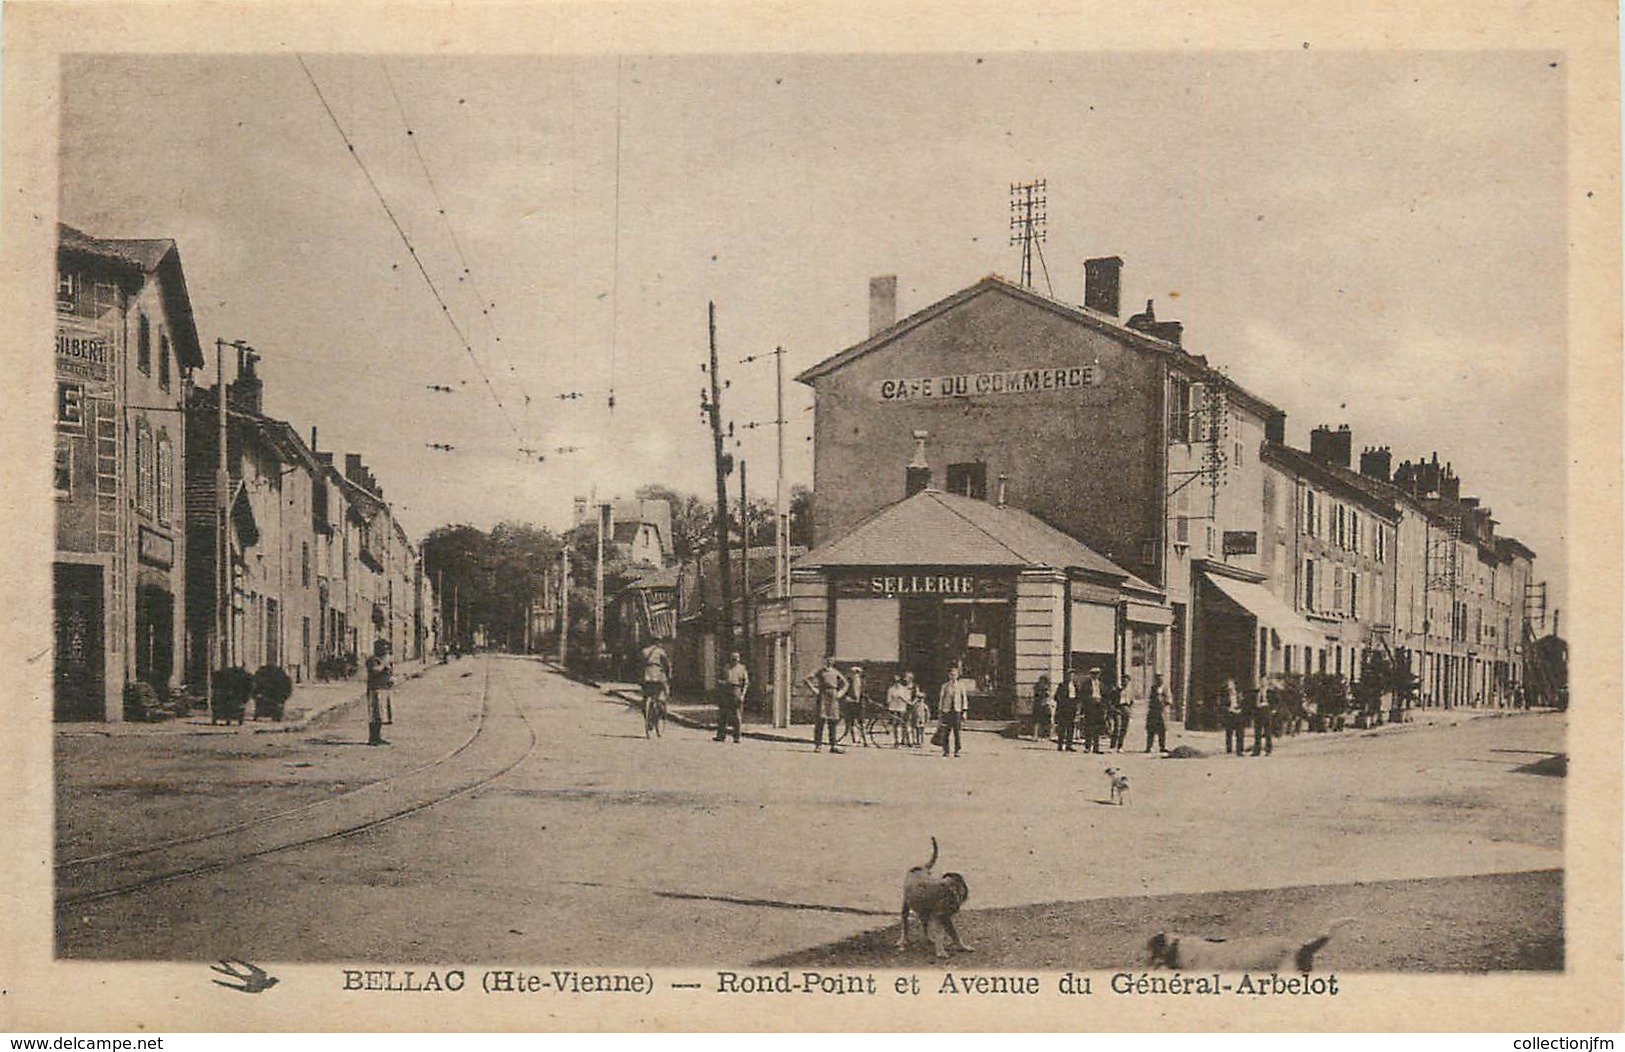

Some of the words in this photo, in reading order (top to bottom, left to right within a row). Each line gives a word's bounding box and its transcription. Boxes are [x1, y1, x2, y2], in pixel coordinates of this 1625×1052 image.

[941, 375, 968, 396] DU
[975, 366, 1094, 394] COMMERCE
[871, 576, 974, 593] SELLERIE
